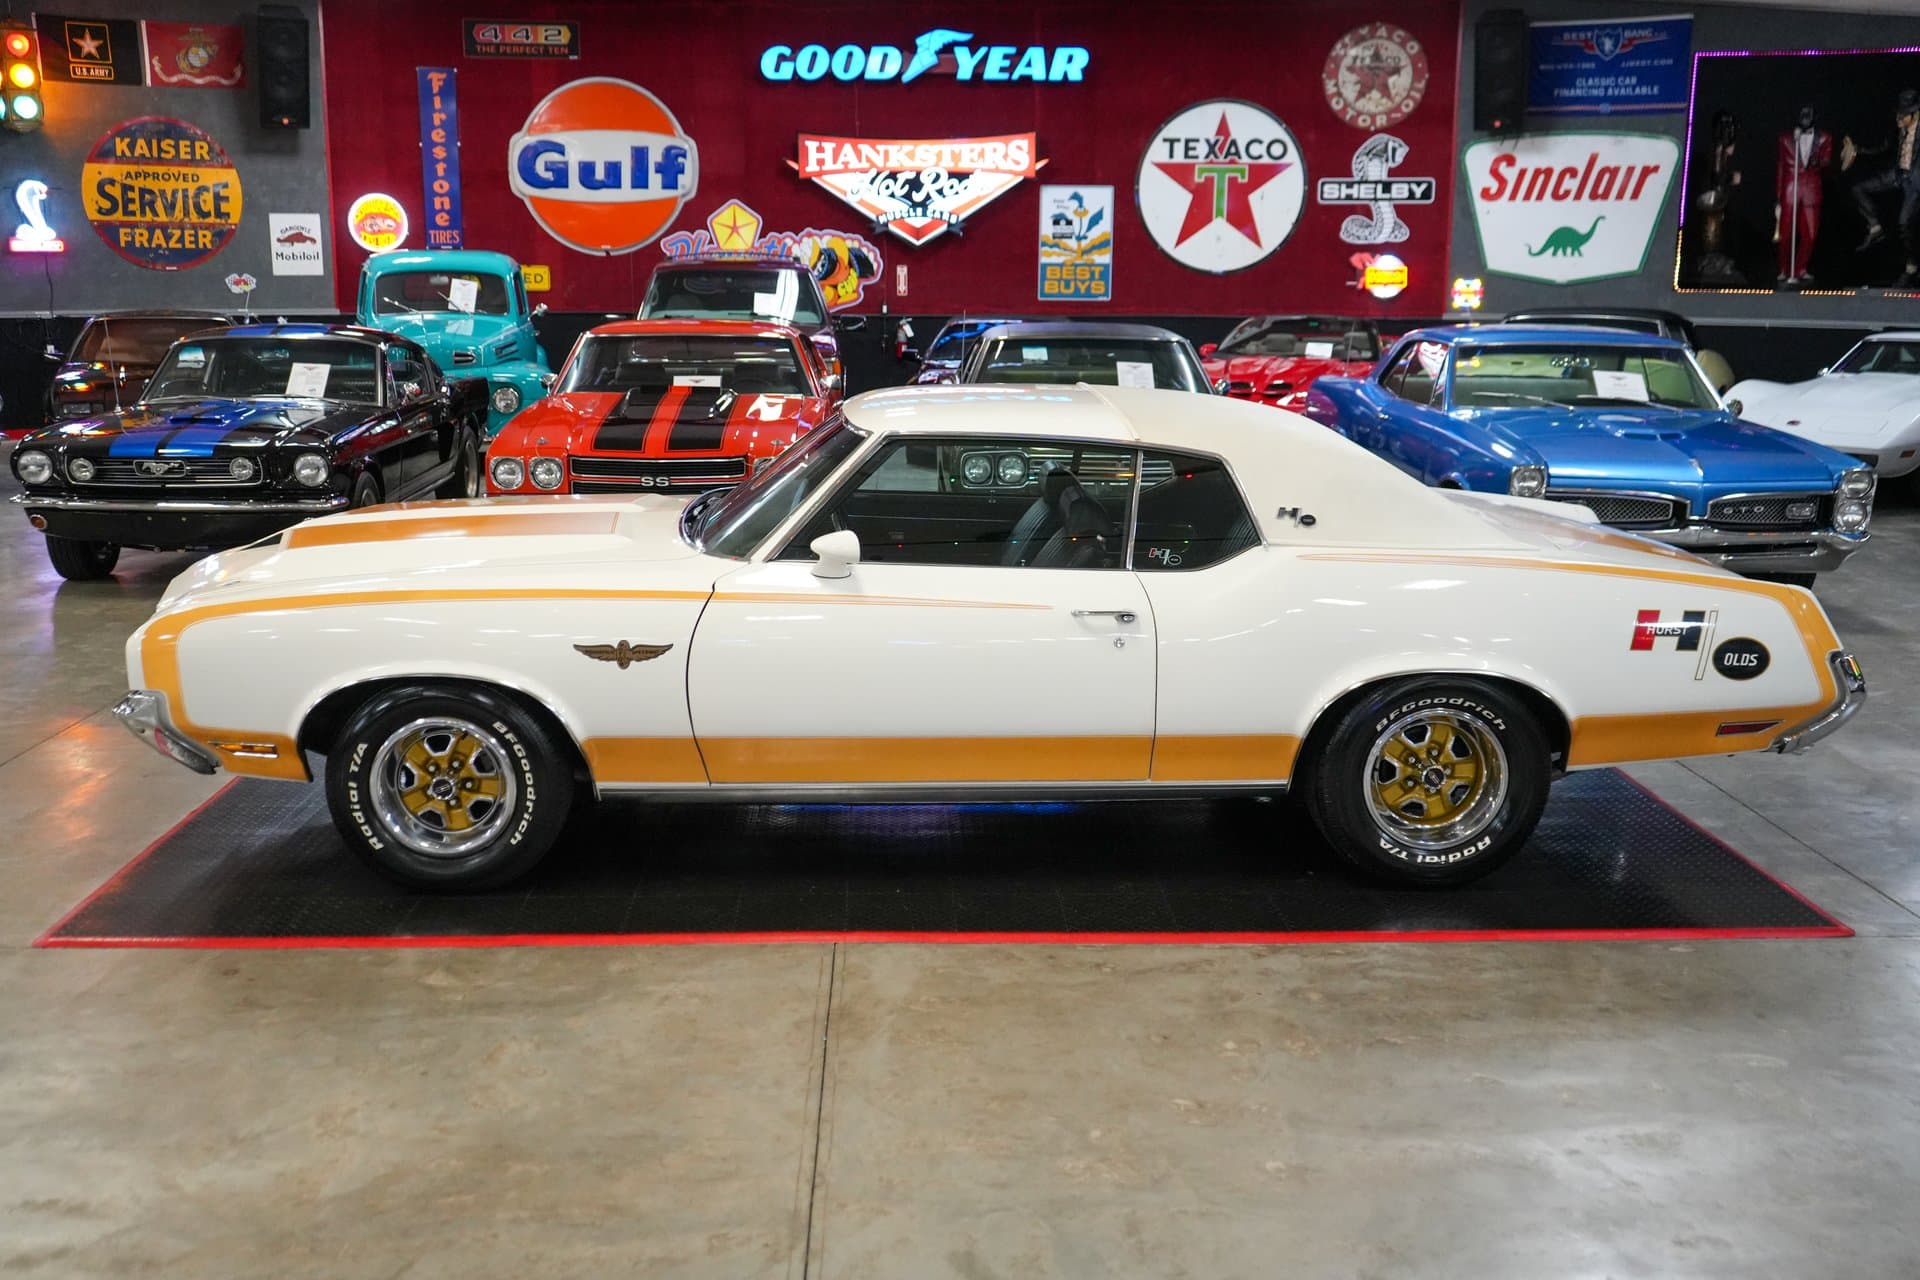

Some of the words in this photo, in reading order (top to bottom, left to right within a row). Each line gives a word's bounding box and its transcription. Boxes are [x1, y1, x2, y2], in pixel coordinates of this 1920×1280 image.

[476, 45, 497, 54] THE
[500, 45, 543, 54] PERFECT
[548, 46, 569, 54] TEN
[75, 66, 90, 76] U.S.
[89, 68, 110, 77] ARMY
[1576, 76, 1616, 87] CLASSIC
[1617, 75, 1638, 86] CAR
[1553, 87, 1605, 98] FINANCING
[1606, 85, 1660, 97] AVAILABLE
[115, 136, 211, 161] KAISER
[427, 72, 452, 227] Firestone
[804, 139, 1030, 172] HANKSTERS
[1163, 137, 1288, 161] TEXACO
[517, 139, 687, 191] Gulf
[124, 170, 200, 183] APPROVED
[846, 167, 916, 201] Hot
[911, 166, 993, 202] Rod
[1480, 152, 1660, 202] Sinclair
[95, 178, 231, 222] SERVICE
[1322, 183, 1429, 200] SHELBY
[878, 207, 923, 224] MUSCLE
[119, 227, 213, 250] FRAZER
[429, 230, 460, 244] TIRES
[275, 251, 320, 261] Mobiloil
[1046, 266, 1104, 280] BEST
[1044, 280, 1106, 294] BUYS
[640, 476, 669, 487] SS
[1723, 506, 1764, 514] GTO
[1646, 624, 1690, 636] HURST
[1724, 652, 1758, 666] OLDS
[1375, 697, 1507, 733] BFGoodrich
[349, 743, 369, 774] T/A
[492, 721, 537, 846] BFGoodrich
[347, 782, 385, 850] Radial
[1379, 837, 1409, 860] T/A
[1416, 836, 1492, 865] Radial
